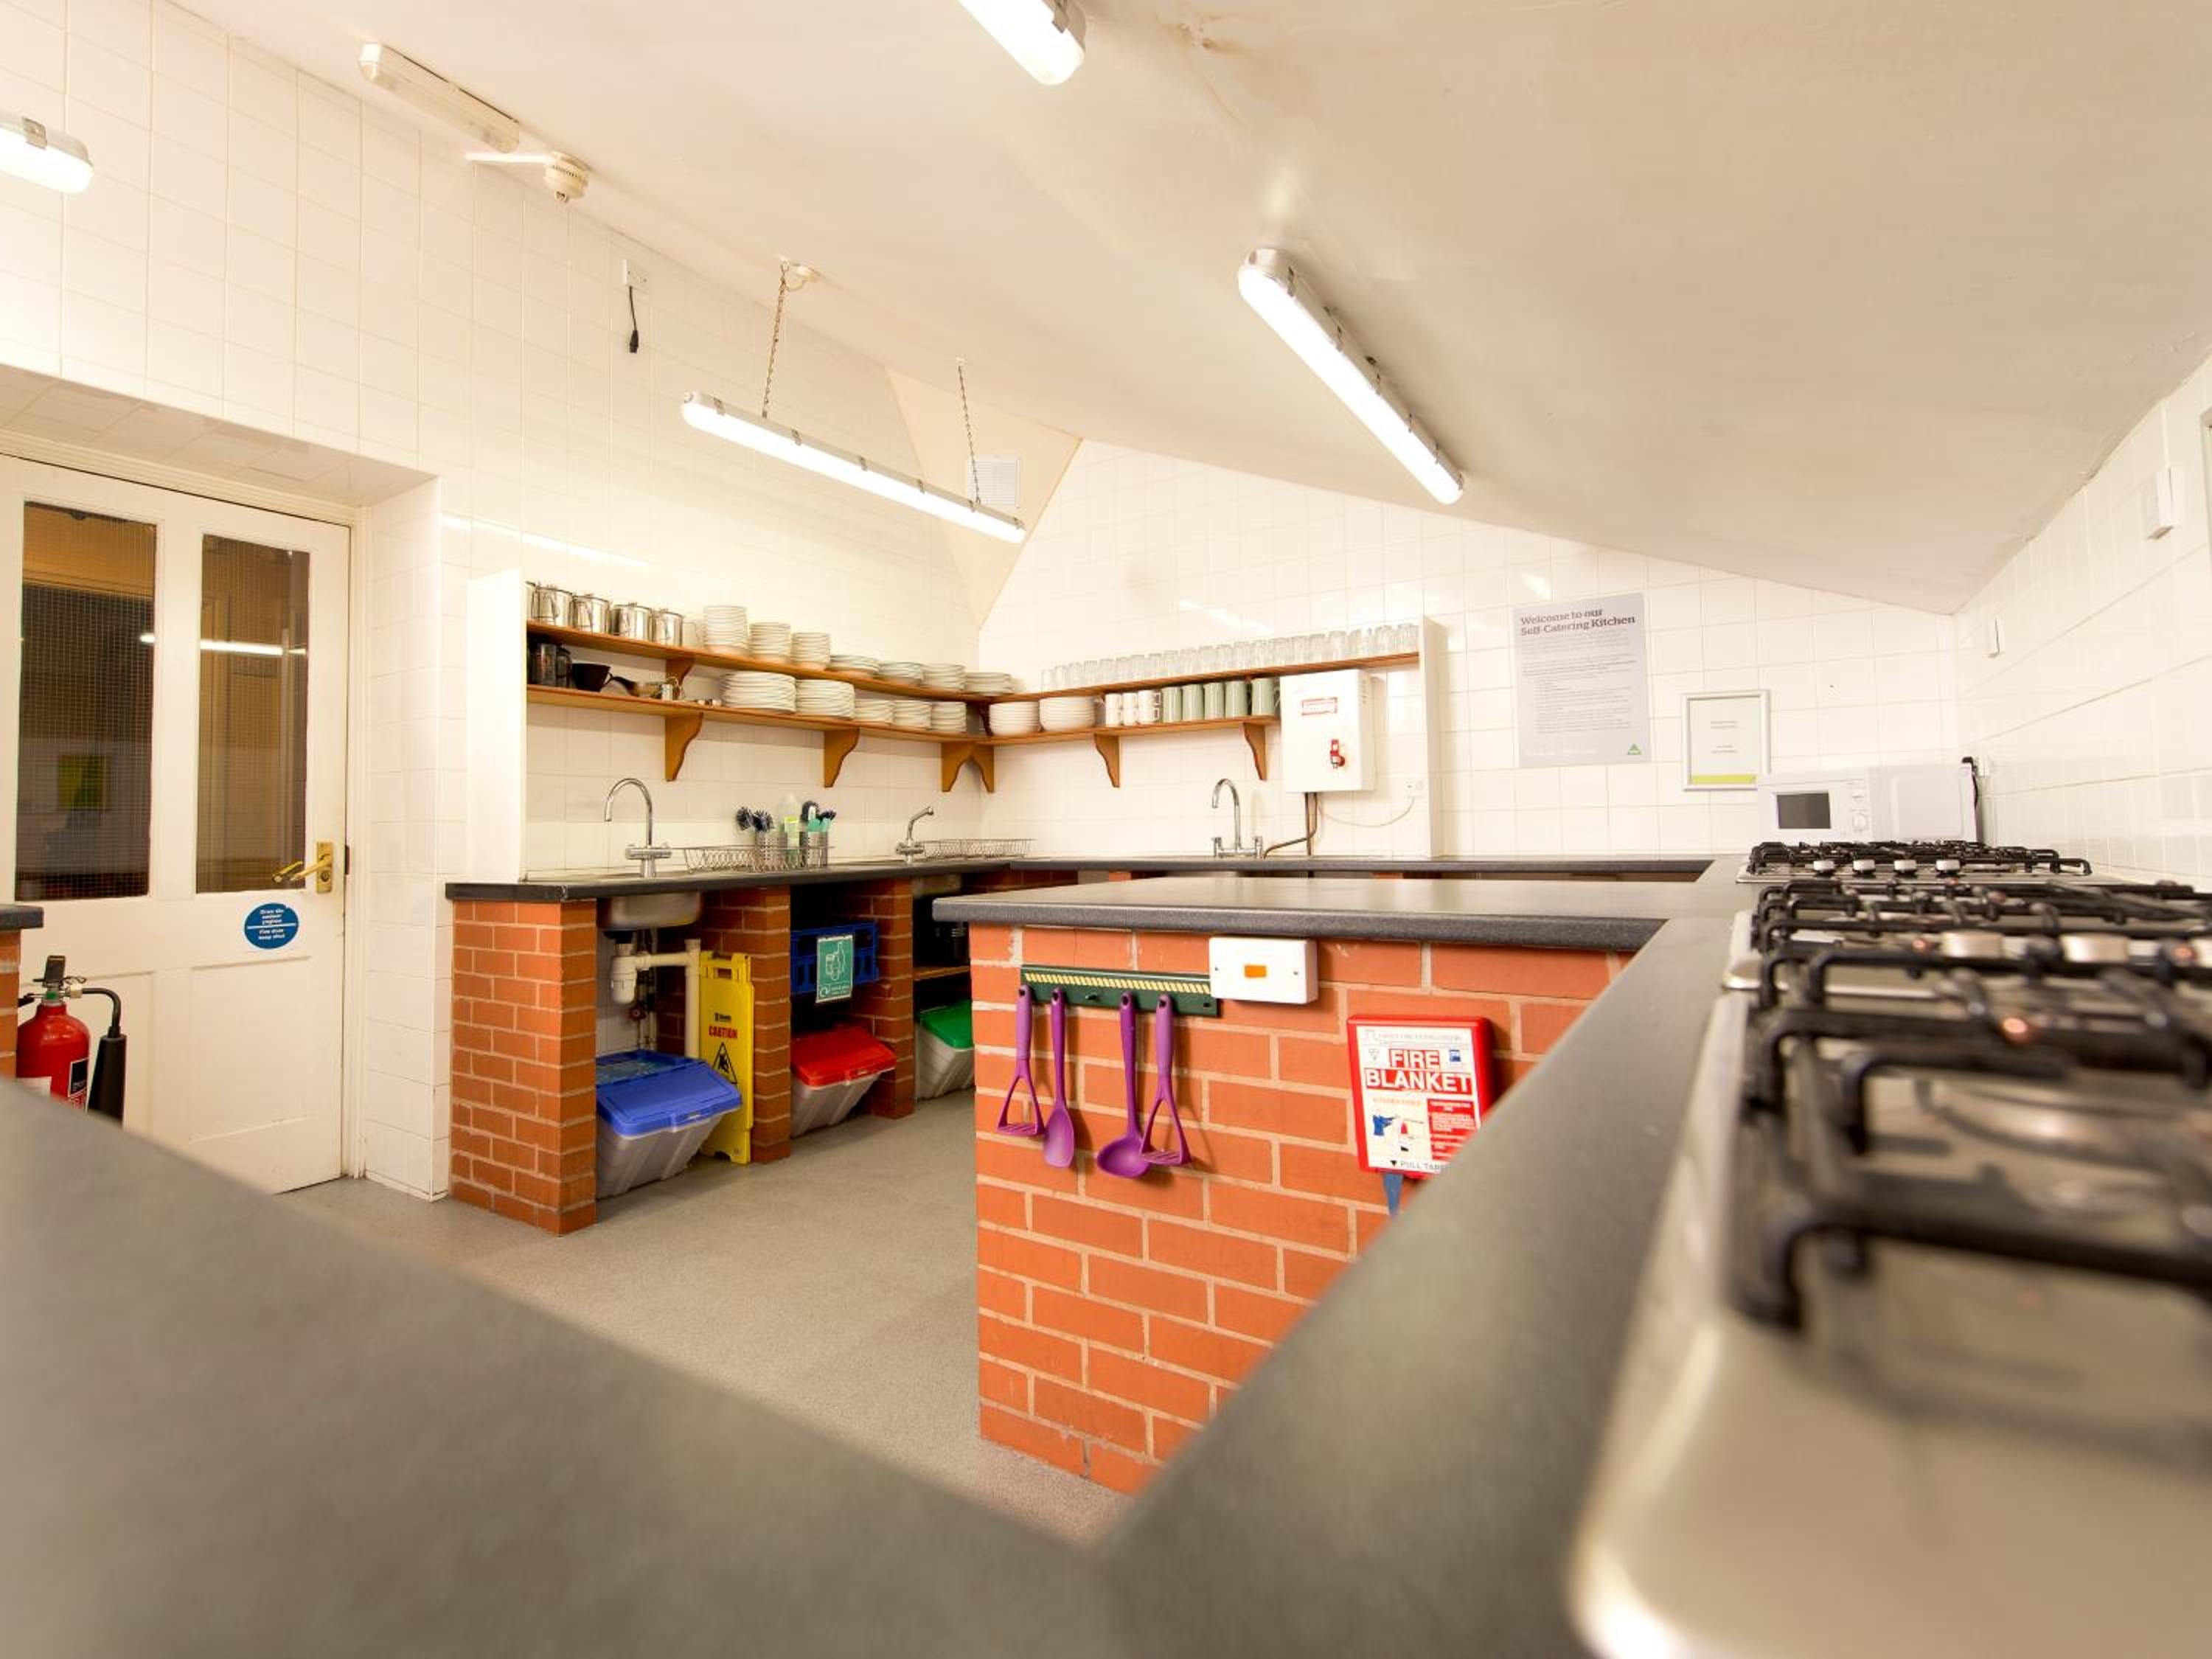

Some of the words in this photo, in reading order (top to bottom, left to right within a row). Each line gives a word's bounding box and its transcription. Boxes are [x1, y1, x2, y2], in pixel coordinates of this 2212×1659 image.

[1521, 613, 1570, 625] Welcome
[1571, 611, 1582, 619] to
[1584, 609, 1604, 618] our
[1591, 616, 1636, 627] Kitchen
[709, 1026, 738, 1039] CAUTION
[1391, 1050, 1439, 1068] FIRE
[1366, 1069, 1471, 1093] BLANKET
[1400, 1161, 1420, 1169] PULL
